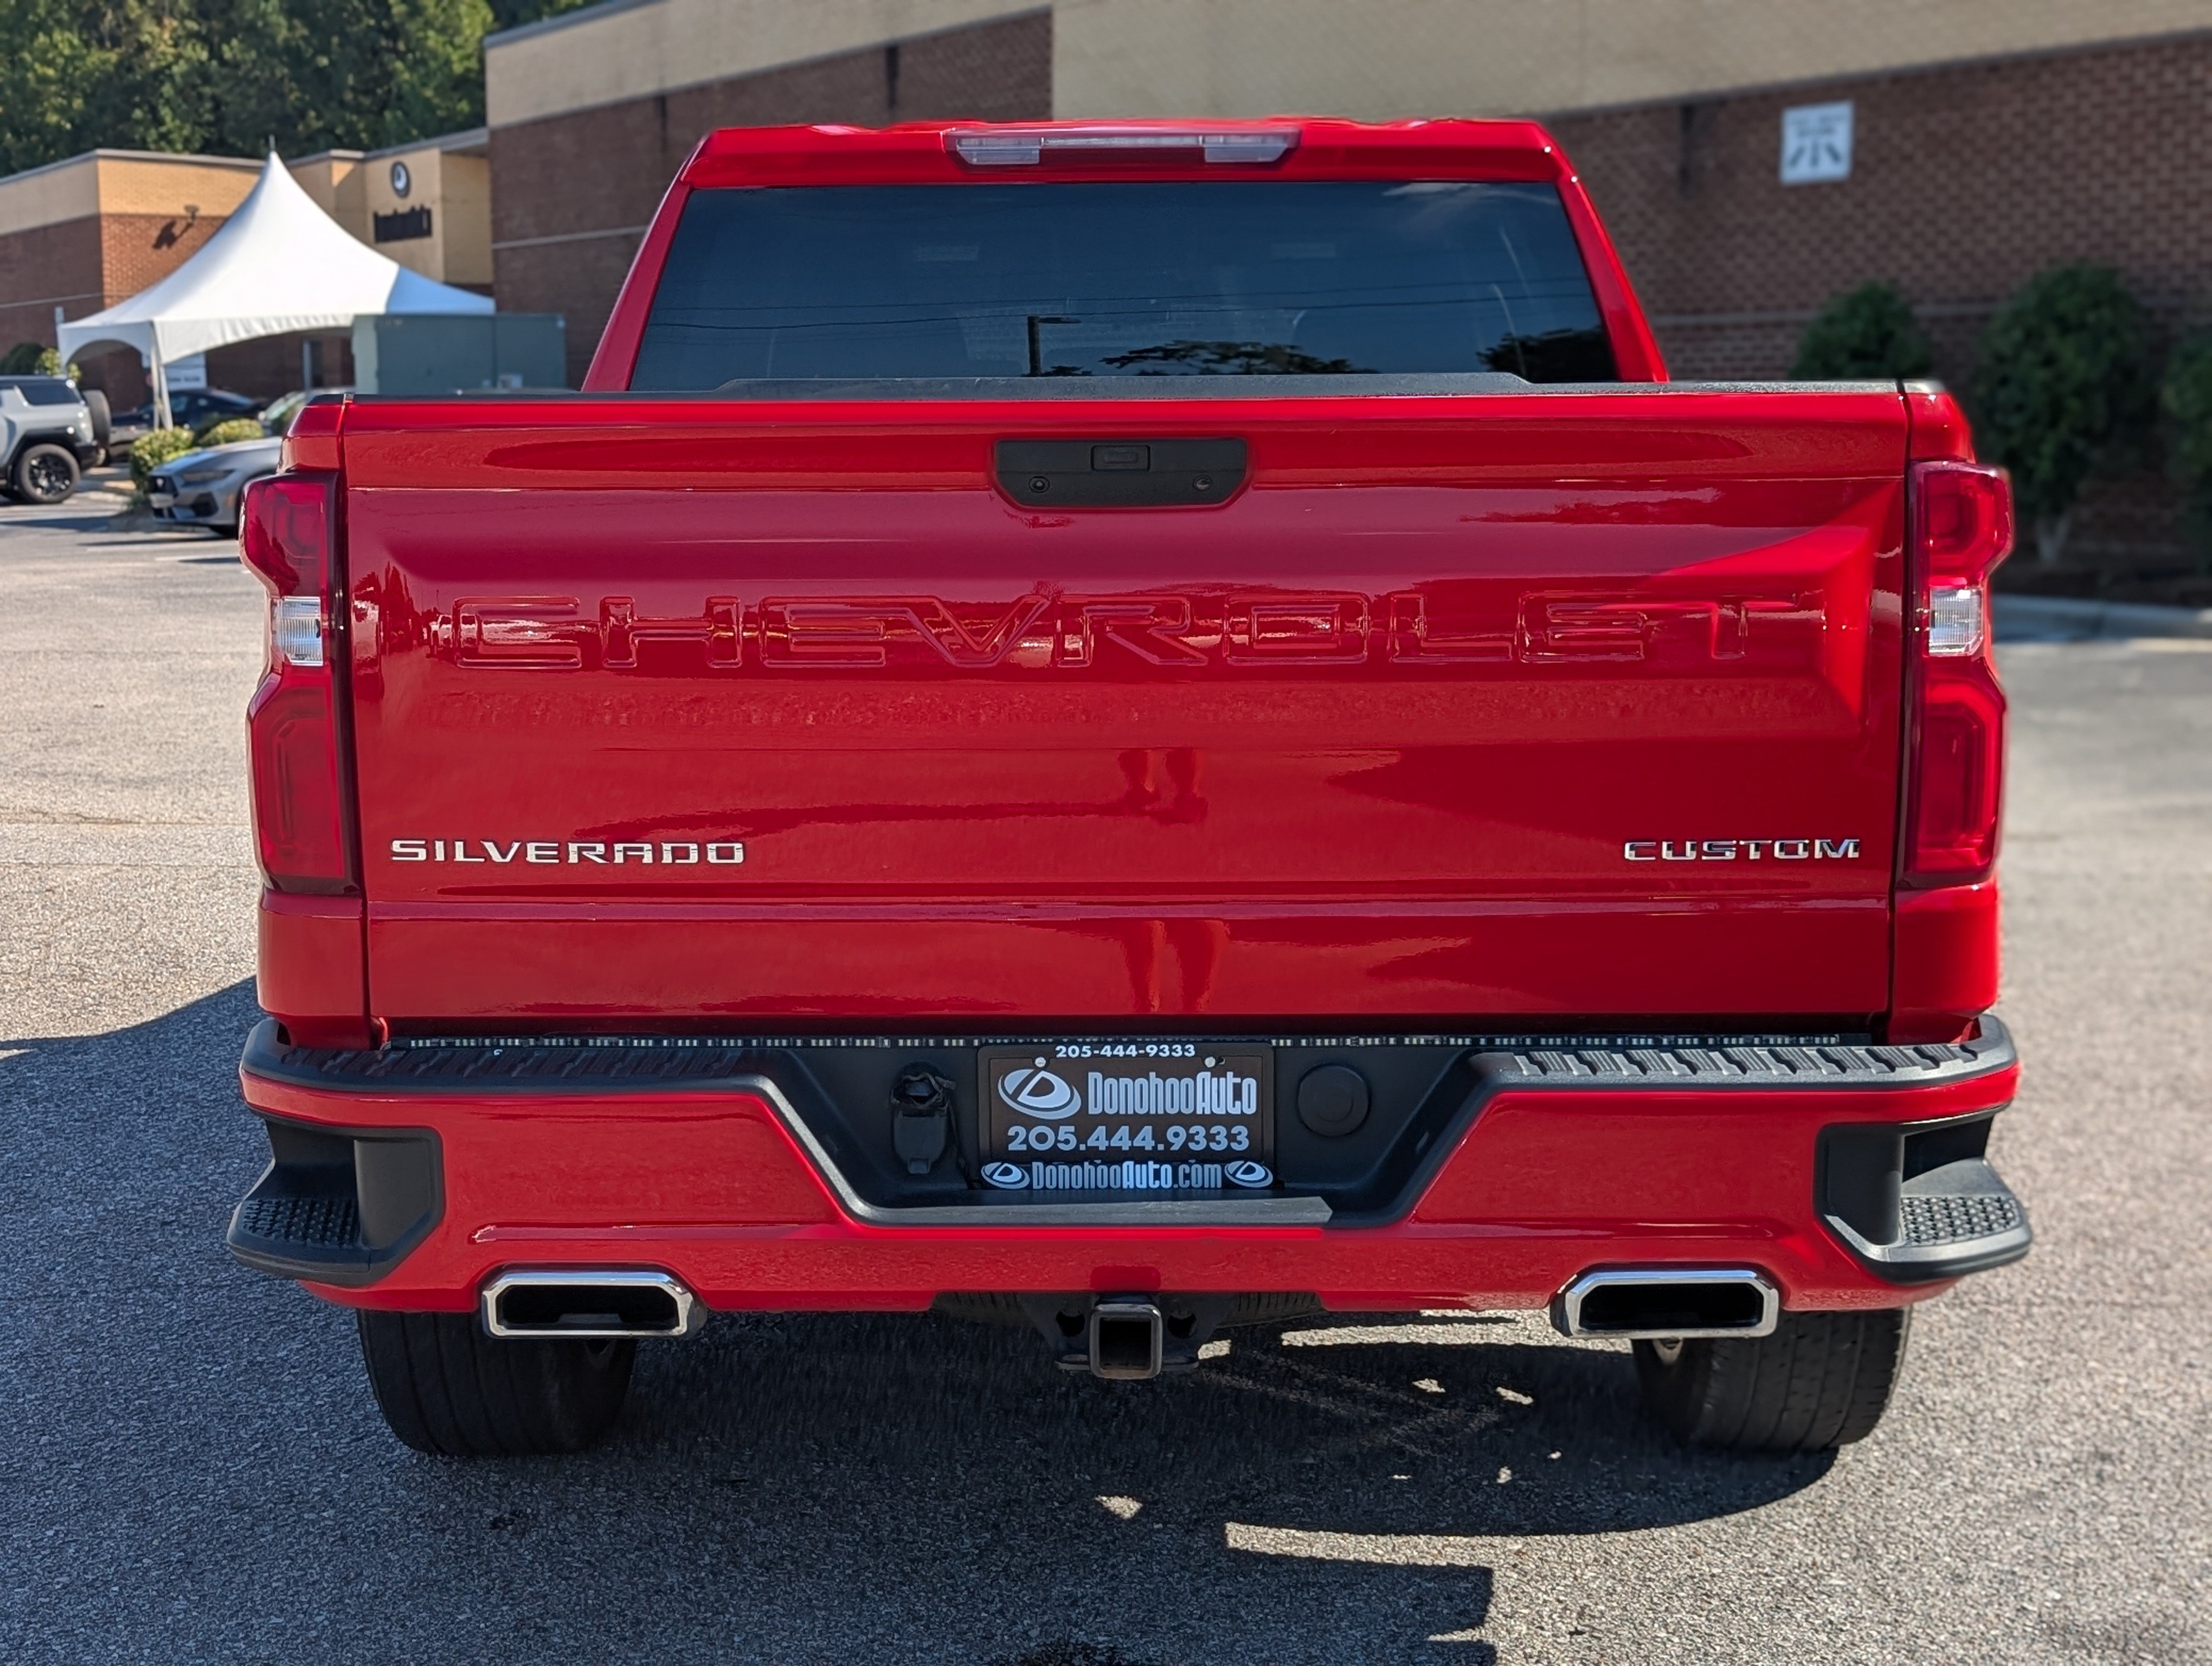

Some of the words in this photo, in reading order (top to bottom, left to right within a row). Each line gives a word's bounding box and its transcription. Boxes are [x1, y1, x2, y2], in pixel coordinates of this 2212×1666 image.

[453, 592, 1801, 668] CHEVROLET
[390, 840, 744, 864] SILVERADO
[1624, 839, 1860, 861] CUSTOM
[1055, 1045, 1196, 1058] 205-444-9333
[1007, 1125, 1249, 1151] 205.444.9333
